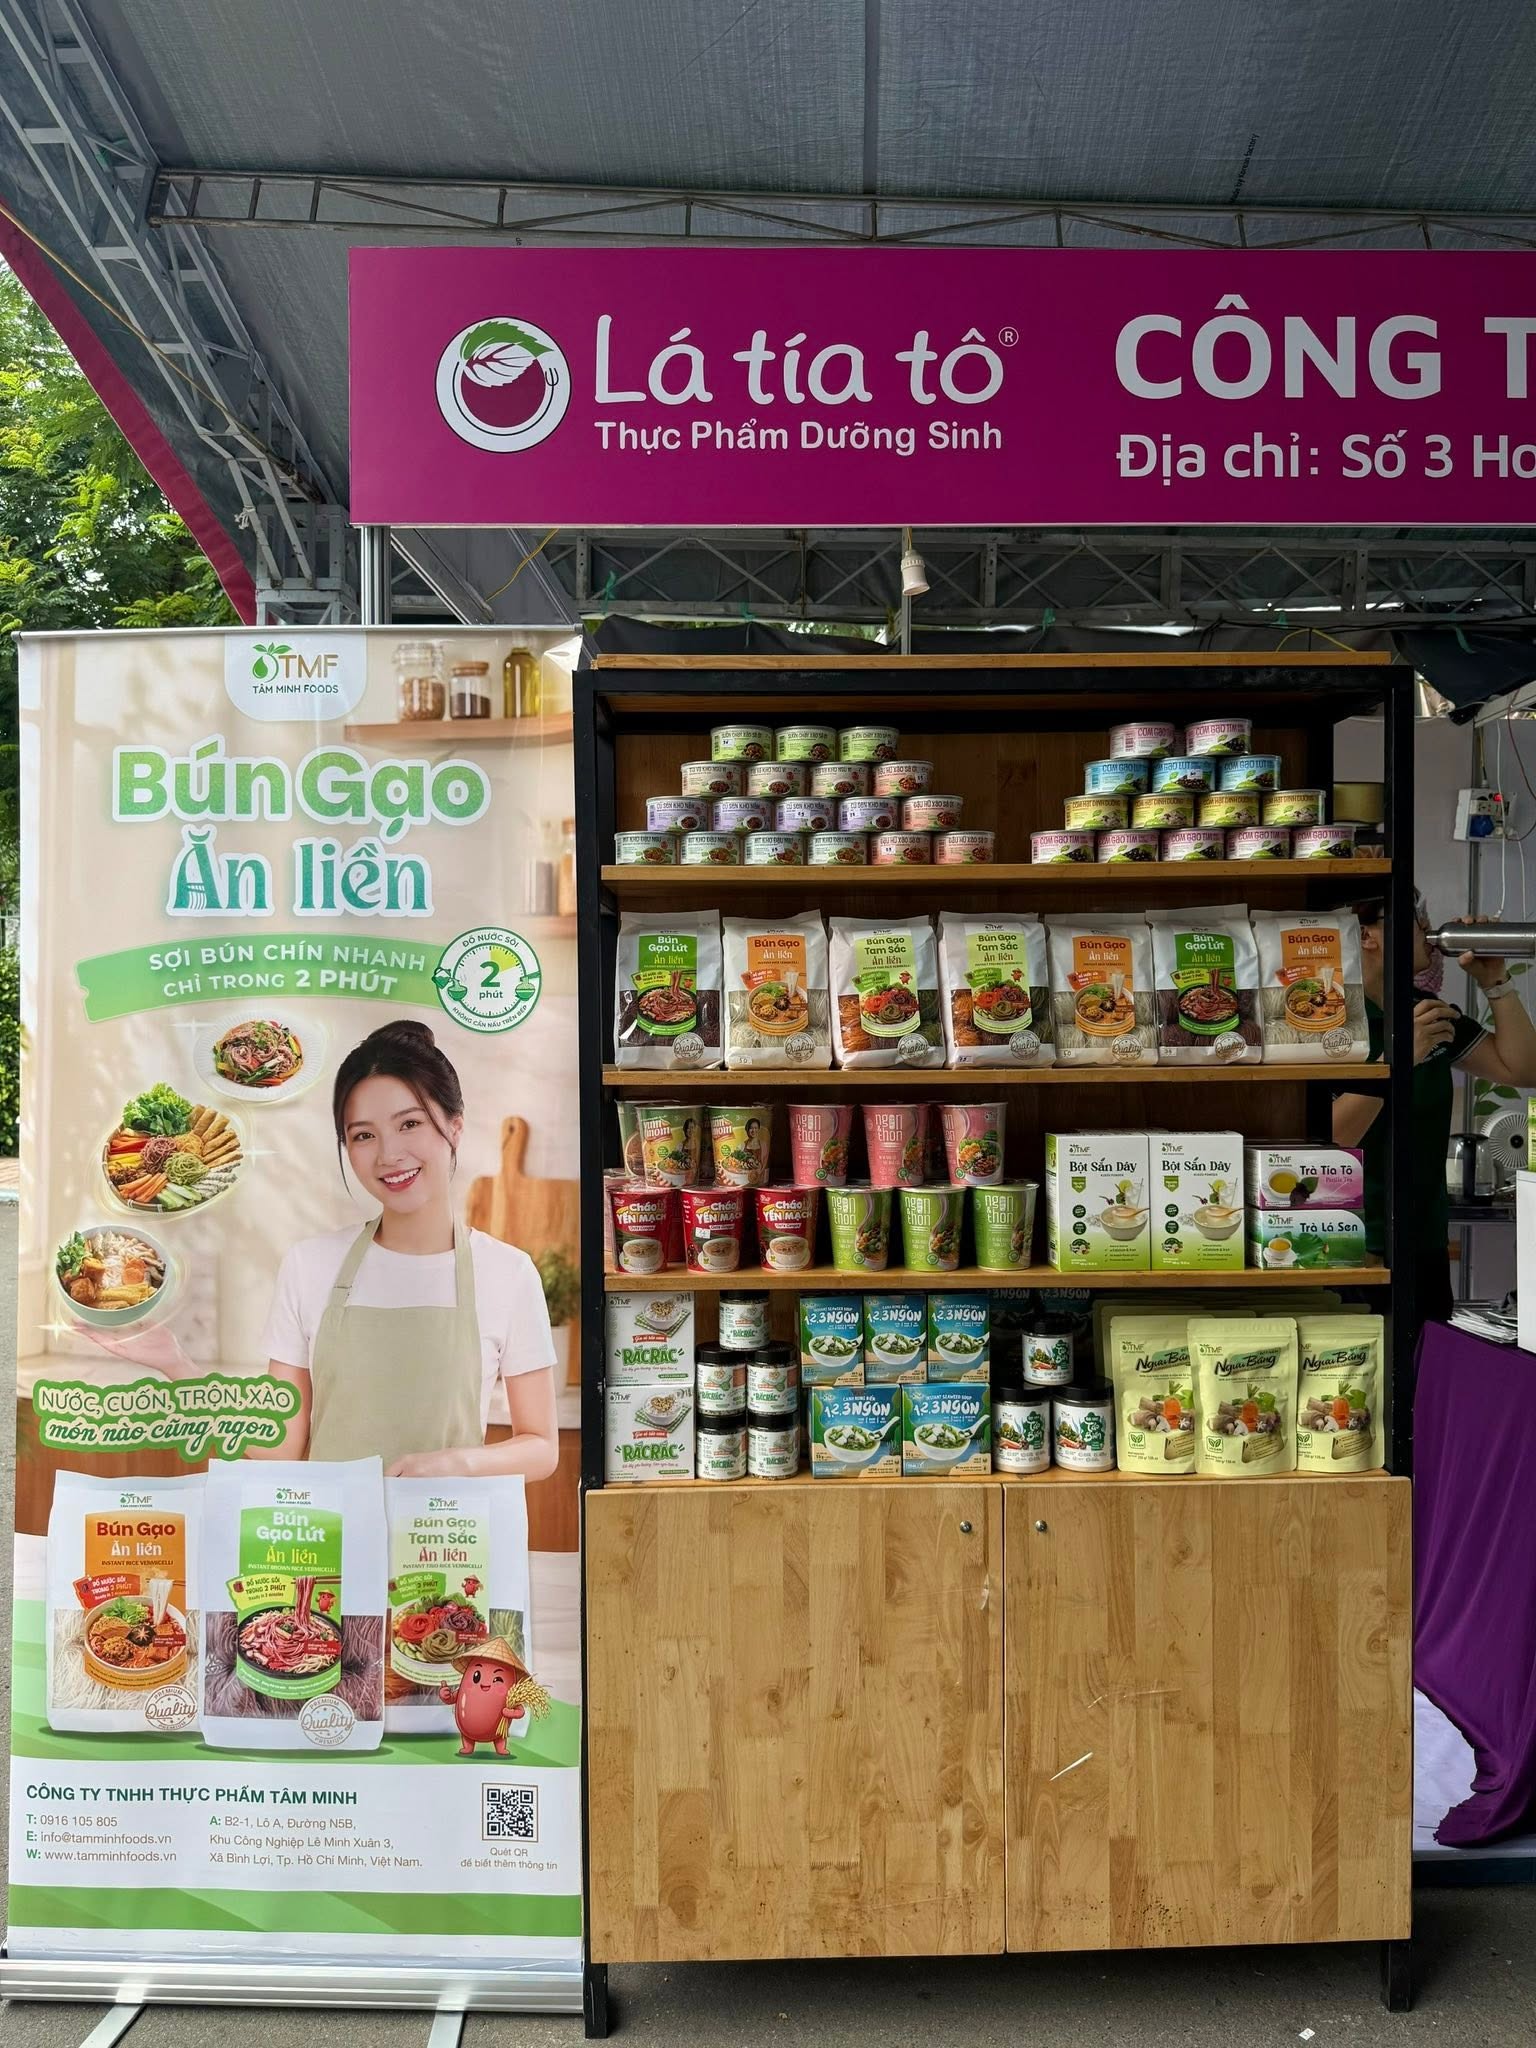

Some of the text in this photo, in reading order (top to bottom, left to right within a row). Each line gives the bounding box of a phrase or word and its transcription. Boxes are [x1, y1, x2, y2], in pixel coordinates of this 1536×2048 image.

[1116, 294, 1441, 400] CÔNG
[595, 315, 1004, 405] Lá tía tô
[594, 417, 1002, 456] Thực Phẩm Dưỡng Sinh
[1116, 434, 1206, 486] Địa
[1224, 432, 1319, 478] chỉ:
[1342, 430, 1407, 478] Số
[1424, 435, 1454, 478] 3
[278, 655, 339, 678] TMF
[253, 684, 339, 694] TÂM MINH FOODS
[116, 739, 486, 839] Bún Gạo
[172, 830, 427, 913] Ăn liền
[478, 933, 503, 942] NƯỚC
[505, 936, 519, 948] SÔI
[658, 936, 679, 945] Bún
[755, 939, 800, 949] Bún Gạo
[887, 937, 905, 945] Gạo
[979, 934, 1017, 943] Bún Gạo
[1080, 940, 1126, 951] Bún Gạo
[1194, 934, 1214, 943] Bún
[1288, 934, 1335, 946] Bún Gạo
[649, 944, 670, 953] Gạo
[865, 947, 886, 955] Tam
[977, 943, 998, 952] Tam
[1185, 942, 1206, 952] Gạo
[149, 941, 425, 972] SỢI BÚN CHÍN NHANH
[480, 961, 501, 988] 2
[164, 969, 398, 997] CHỈ TRONG 2 PHÚT
[479, 990, 504, 1000] phút
[453, 1007, 473, 1024] KHÔNG
[473, 1019, 486, 1028] CẦN
[502, 1015, 518, 1025] TRÊN
[517, 1005, 528, 1016] BẾP
[1070, 1162, 1088, 1174] Bột
[1091, 1158, 1113, 1172] Sắn
[1162, 1157, 1232, 1173] Bột Sắn Dây
[1300, 1166, 1353, 1176] Trà Tía Tô
[776, 1201, 803, 1210] Cháo
[763, 1209, 813, 1222] YẾN MẠCH
[1300, 1222, 1358, 1232] Trà Lá Sen
[41, 1385, 291, 1415] NƯỚC, CUỐN, TRỘN, XÀO
[49, 1417, 276, 1452] món nào cũng ngon
[273, 1511, 309, 1527] Bún
[414, 1517, 477, 1531] Bún Gạo
[97, 1521, 176, 1540] Bún Gạo
[257, 1526, 326, 1545] Gạo Lứt
[408, 1530, 477, 1544] Tam Sắc
[111, 1540, 162, 1556] Ăn liền
[267, 1546, 317, 1564] Ăn liền
[419, 1546, 467, 1562] Ăn liền
[145, 1702, 197, 1719] Quality
[301, 1711, 355, 1730] Quality
[27, 1782, 75, 1800] CÔNG
[80, 1788, 101, 1800] TY
[106, 1789, 154, 1801] TNHH
[159, 1786, 210, 1804] THỰC
[270, 1788, 307, 1804] TÂM
[313, 1792, 357, 1805] MINH
[26, 1814, 118, 1827] T: 0916 105 805
[210, 1816, 356, 1831] A: B2-1, Lô A, Đường N5B,
[27, 1831, 172, 1844] E: info@tamminhfoods.vn
[210, 1835, 394, 1850] Khu Công Nghiệp Lê Minh Xuân 3,
[27, 1849, 177, 1862] W: www.tamminhfoods.vn
[490, 1847, 528, 1857] Quét QR
[210, 1853, 423, 1868] Xã Bình Lợi, Tp. Hồ Chí Minh, Việt Nam.
[475, 1859, 492, 1868] biết
[494, 1860, 517, 1868] thêm
[519, 1861, 544, 1871] thông
[547, 1862, 558, 1870] tin
